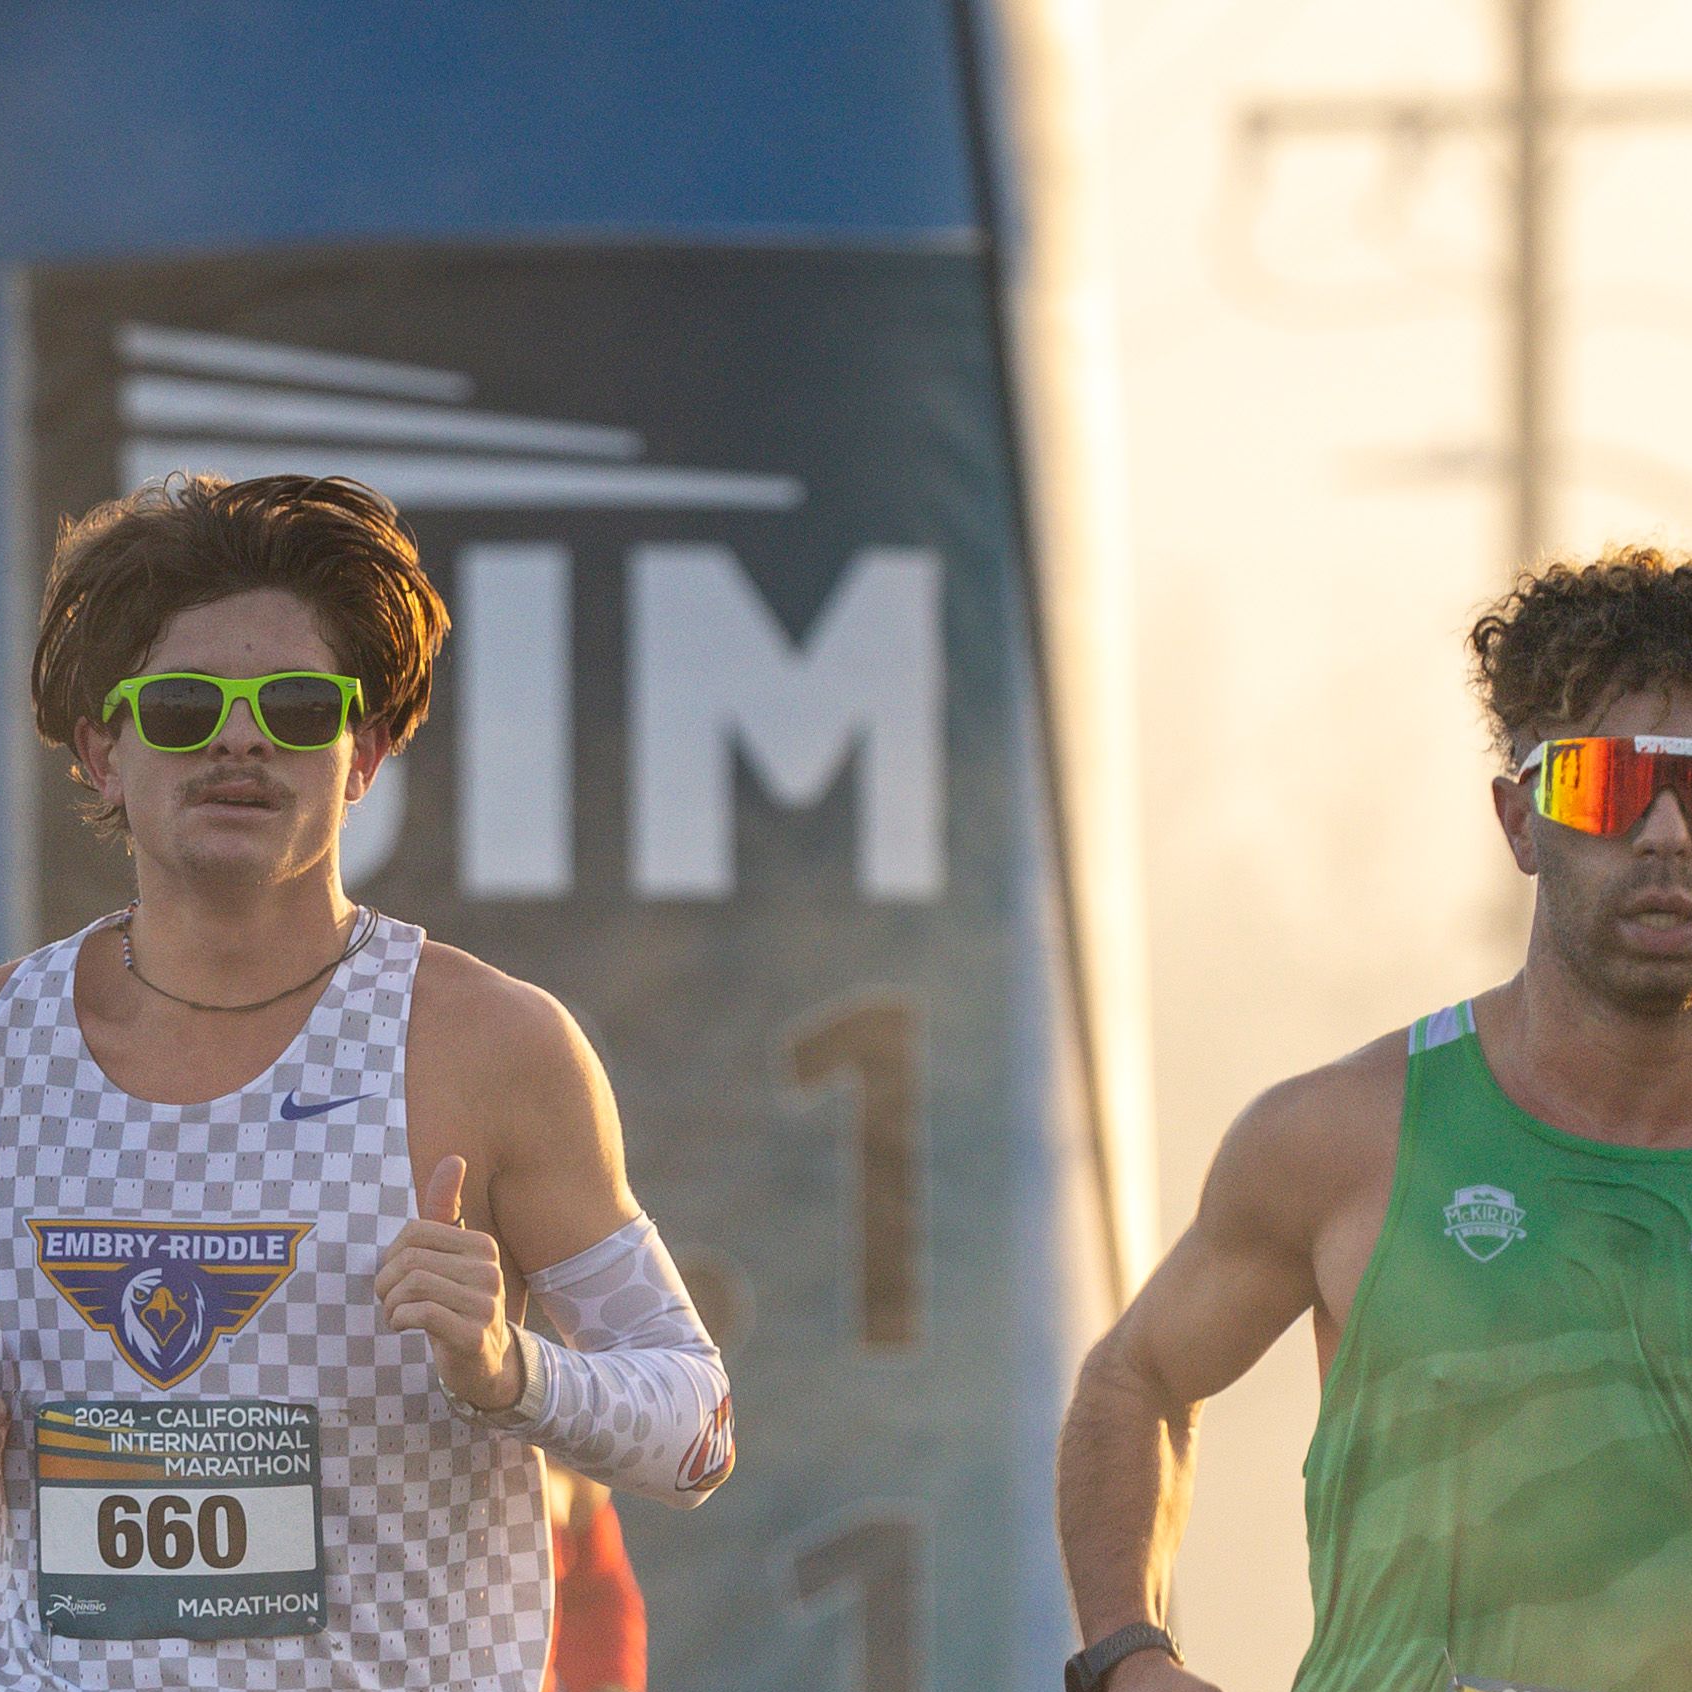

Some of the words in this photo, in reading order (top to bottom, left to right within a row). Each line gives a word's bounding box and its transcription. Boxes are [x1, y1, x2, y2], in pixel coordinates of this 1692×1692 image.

[343, 543, 946, 900] IM
[46, 1232, 285, 1260] EMBRY-RIDDLE
[74, 1407, 135, 1428] 2024
[157, 1406, 310, 1428] CALIFORNIA
[110, 1430, 311, 1452] INTERNATIONAL
[165, 1453, 311, 1477] MARATHON
[97, 1494, 248, 1570] 660
[178, 1594, 319, 1618] MARATHON
